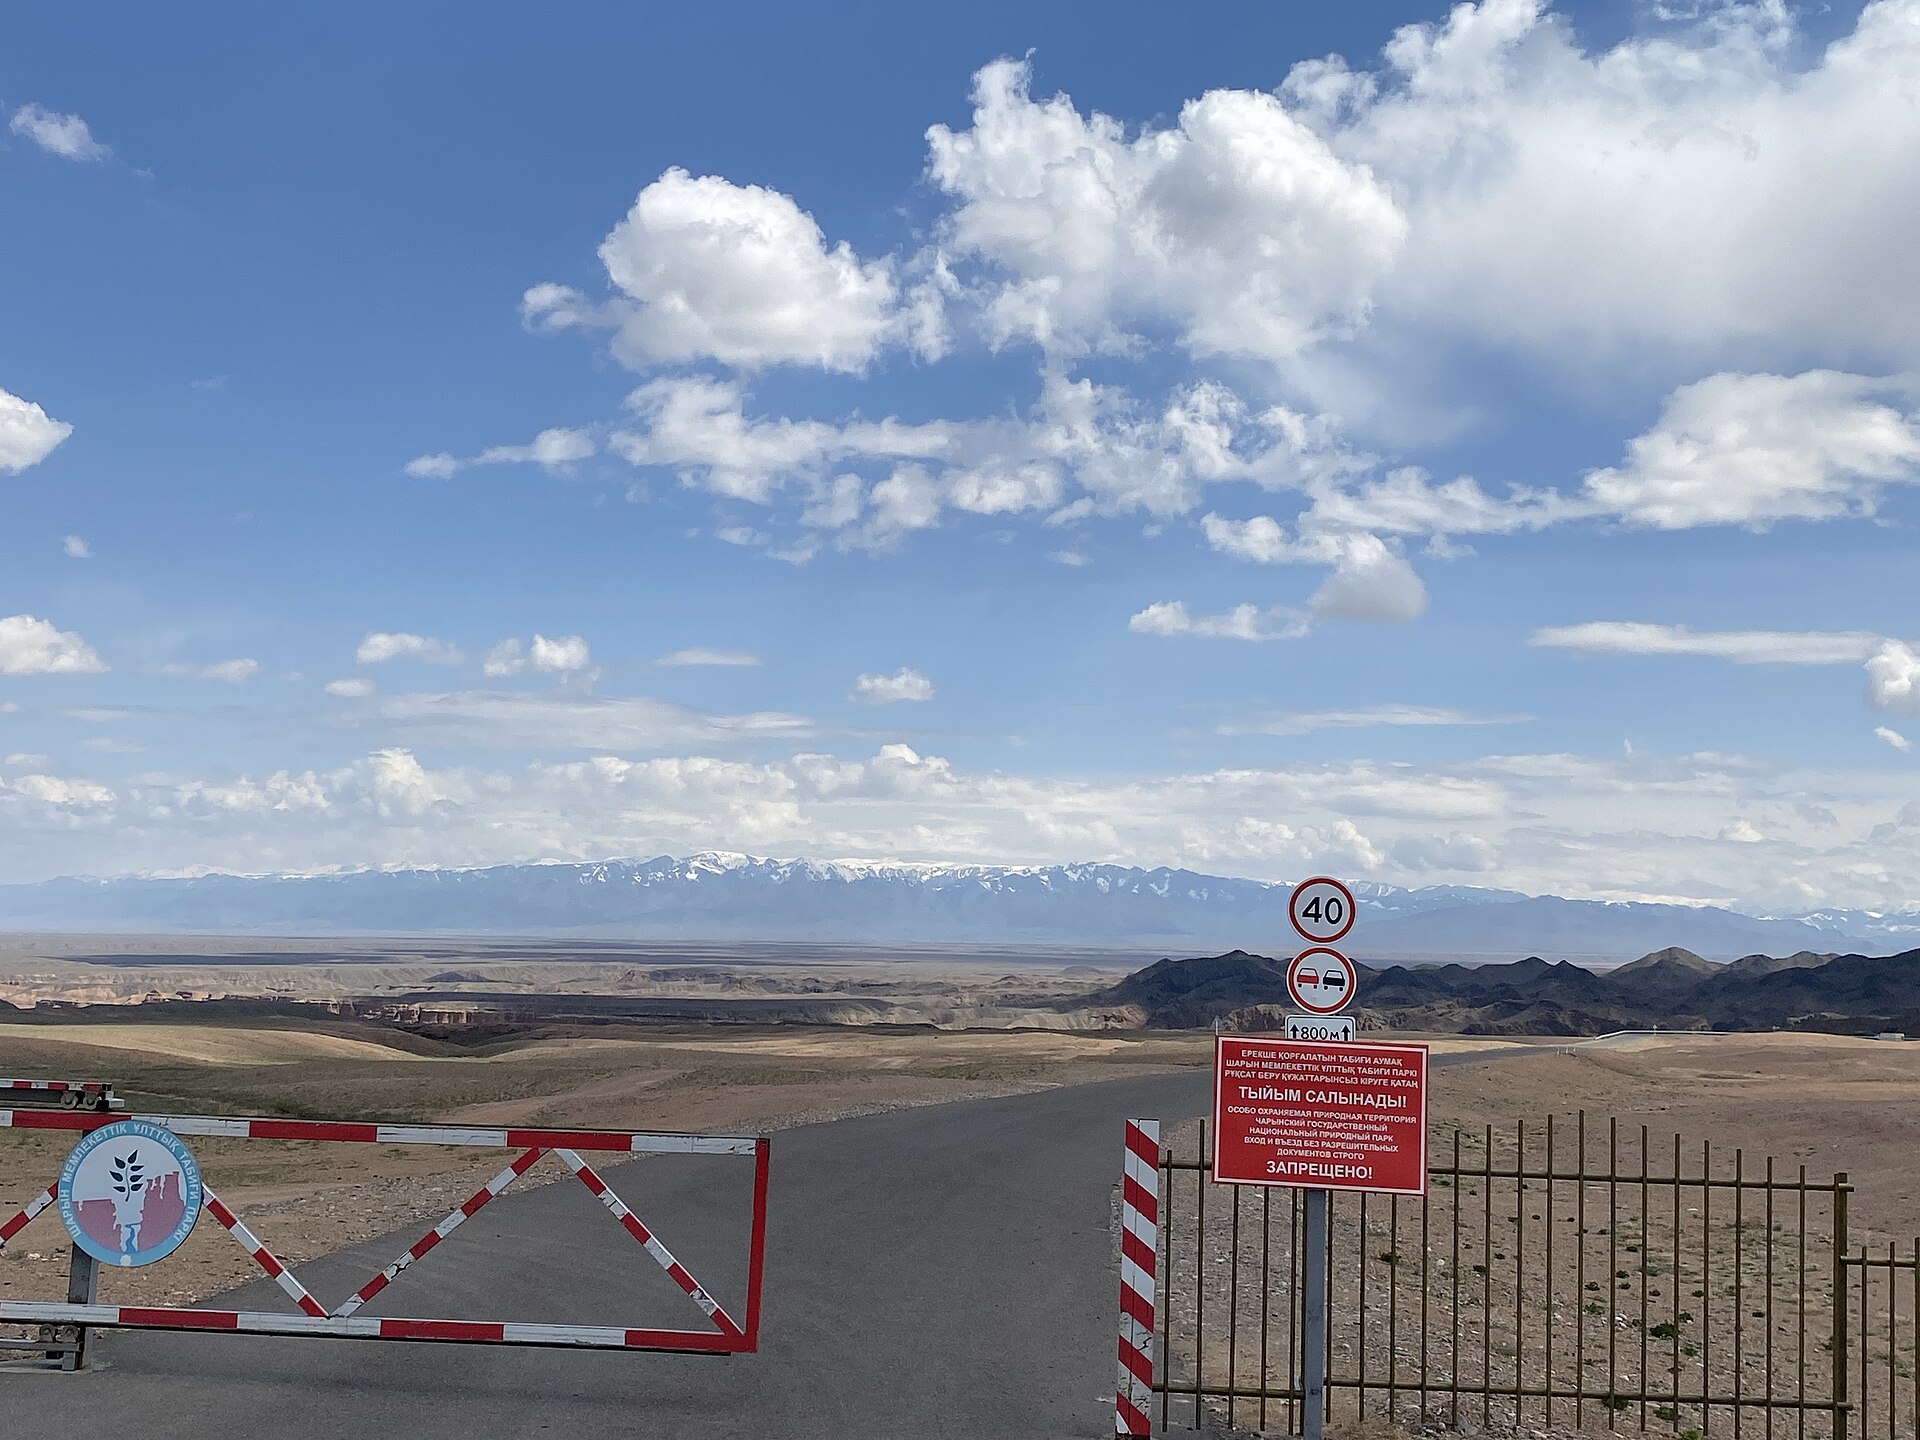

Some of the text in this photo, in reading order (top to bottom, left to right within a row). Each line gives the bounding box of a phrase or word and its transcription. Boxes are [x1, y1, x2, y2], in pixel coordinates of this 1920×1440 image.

[1302, 896, 1342, 924] 40
[1226, 1059, 1260, 1068] ШАРЫН
[1262, 1062, 1319, 1071] МЕМЛЕКЕТТІК
[1242, 1050, 1276, 1059] ЕРЕКШЕ
[1278, 1052, 1336, 1060] ҚОРҒАЛАТЫН
[1373, 1058, 1402, 1066] АУМАҚ
[1258, 1072, 1280, 1080] БЕРУ
[1360, 1078, 1389, 1086] КІРУГЕ
[1390, 1080, 1418, 1089] ҚАТАҢ
[1239, 1085, 1406, 1109] ТЫЙЫМ САЛЫНАДЫ!
[1228, 1106, 1416, 1123] ОСОБО ОХРАНЯЕМАЯ ПРИРОДНАЯ ТЕРРИТОРИЯ
[1256, 1117, 1387, 1131] ЧАРЫНСКИЙ ГОСУДАРСТВЕННЫЙ
[1249, 1127, 1317, 1137] НАЦИОНАЛЬНЫЙ
[1319, 1131, 1370, 1141] ПРИРОДНЫЙ
[62, 1123, 128, 1182] МЕМЛЕКЕТТІК
[1244, 1137, 1265, 1145] ВХОД
[1275, 1139, 1302, 1147] ВЪЕЗД
[1321, 1141, 1398, 1152] РАЗРЕШИТЕЛЬНЫХ
[1277, 1149, 1364, 1160] ДОКУМЕНТОВ СТРОГО
[1266, 1160, 1372, 1179] ЗАПРЕЩЕНО!
[60, 1189, 81, 1238] ШАРЫН
